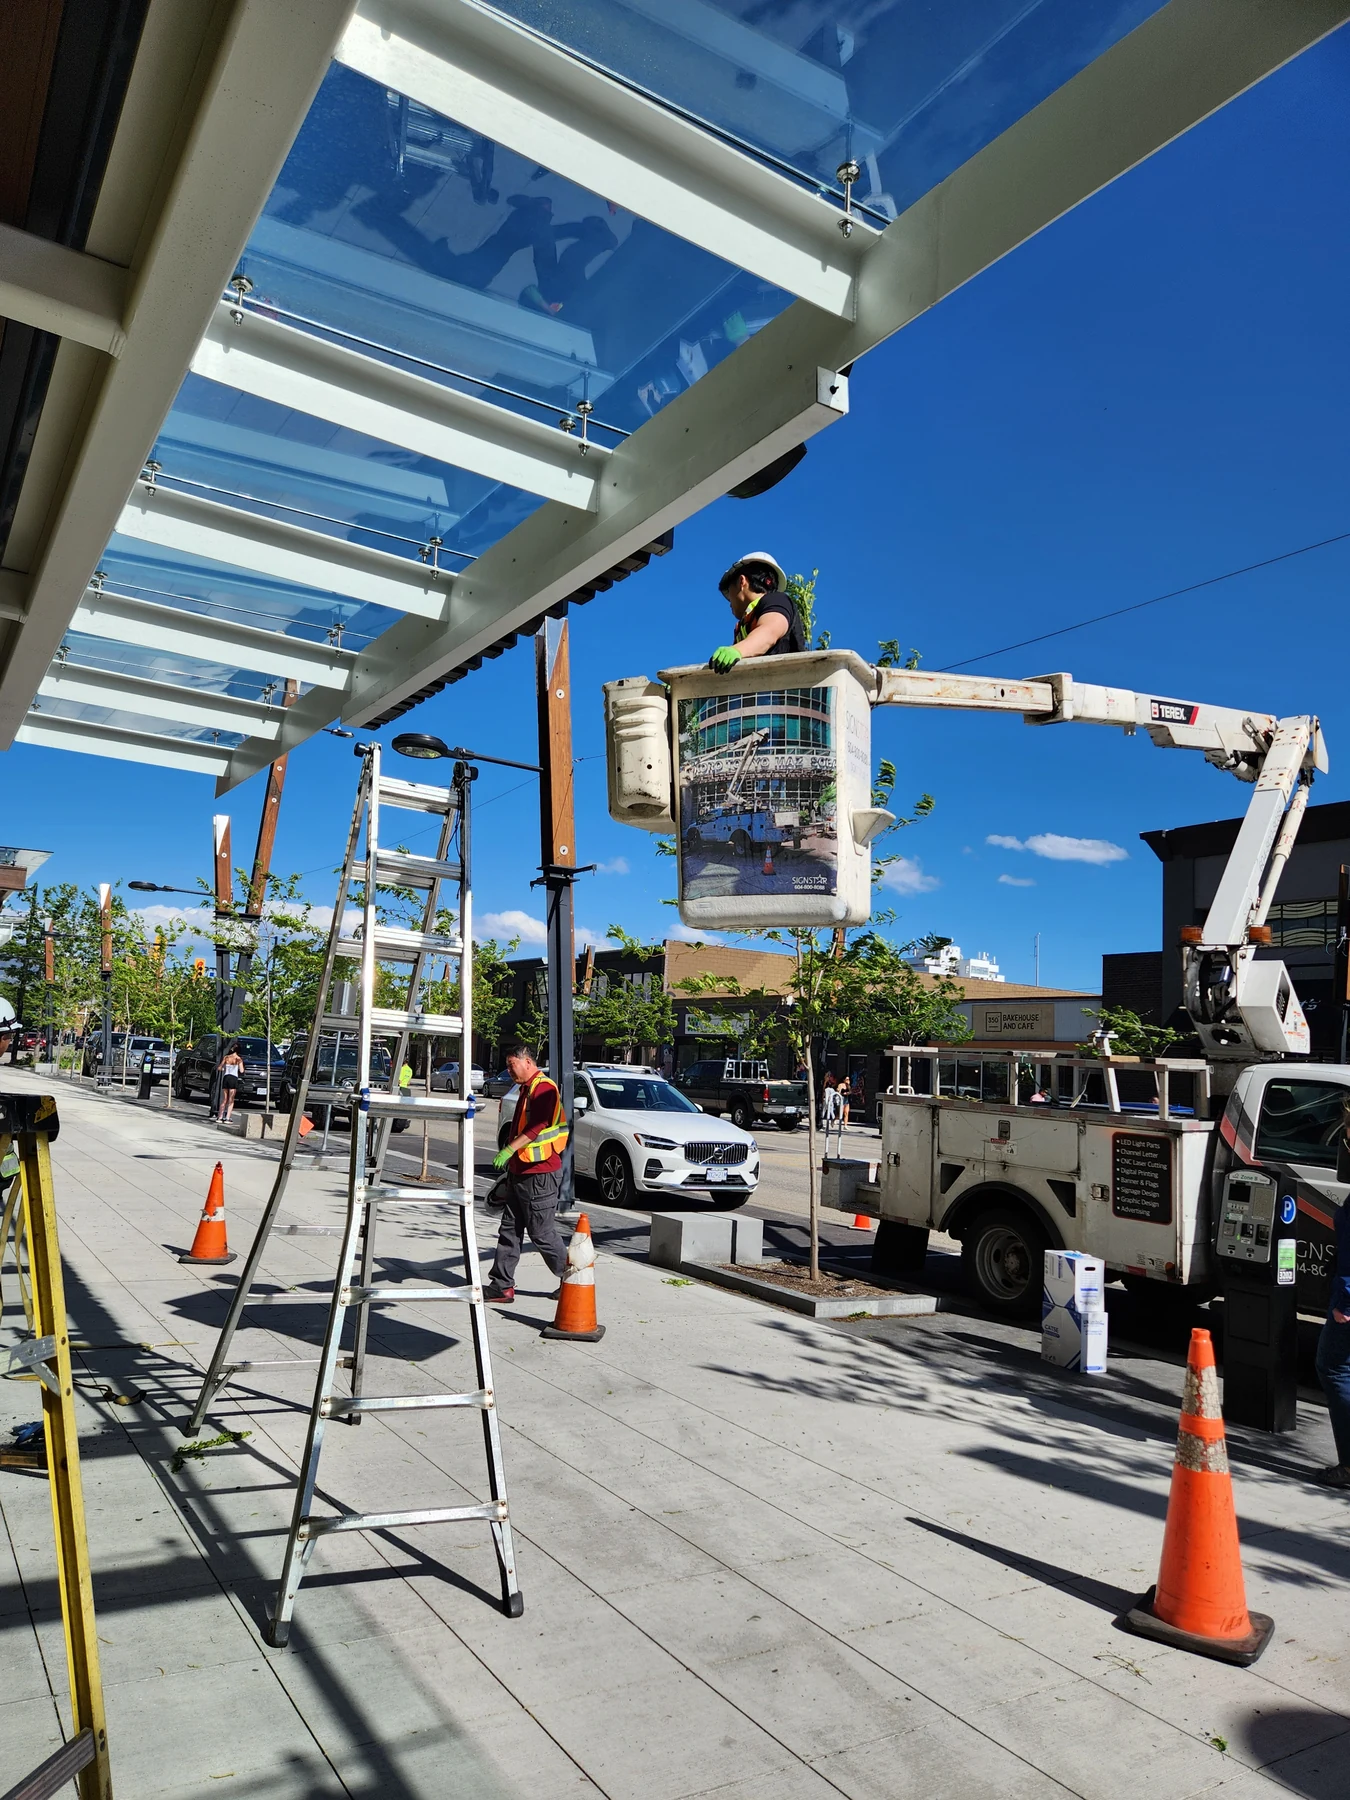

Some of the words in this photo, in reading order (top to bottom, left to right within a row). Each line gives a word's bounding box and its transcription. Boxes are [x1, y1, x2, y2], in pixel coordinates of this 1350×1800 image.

[1160, 705, 1184, 720] TEREX
[726, 757, 770, 771] TOYO
[791, 874, 827, 884] SIGNSTAR
[1002, 1022, 1016, 1030] AND
[1017, 1022, 1035, 1030] CAFE
[1132, 1140, 1145, 1148] Light
[1120, 1149, 1141, 1157] Channel
[1147, 1161, 1168, 1170] Cutting
[1138, 1170, 1159, 1179] Printing
[1120, 1177, 1139, 1185] Banner
[1145, 1180, 1159, 1188] Flags
[1120, 1186, 1141, 1195] Signage
[1141, 1190, 1160, 1198] Design
[1120, 1196, 1141, 1205] Graphic
[1141, 1199, 1160, 1208] Design
[1120, 1206, 1150, 1217] Advertising
